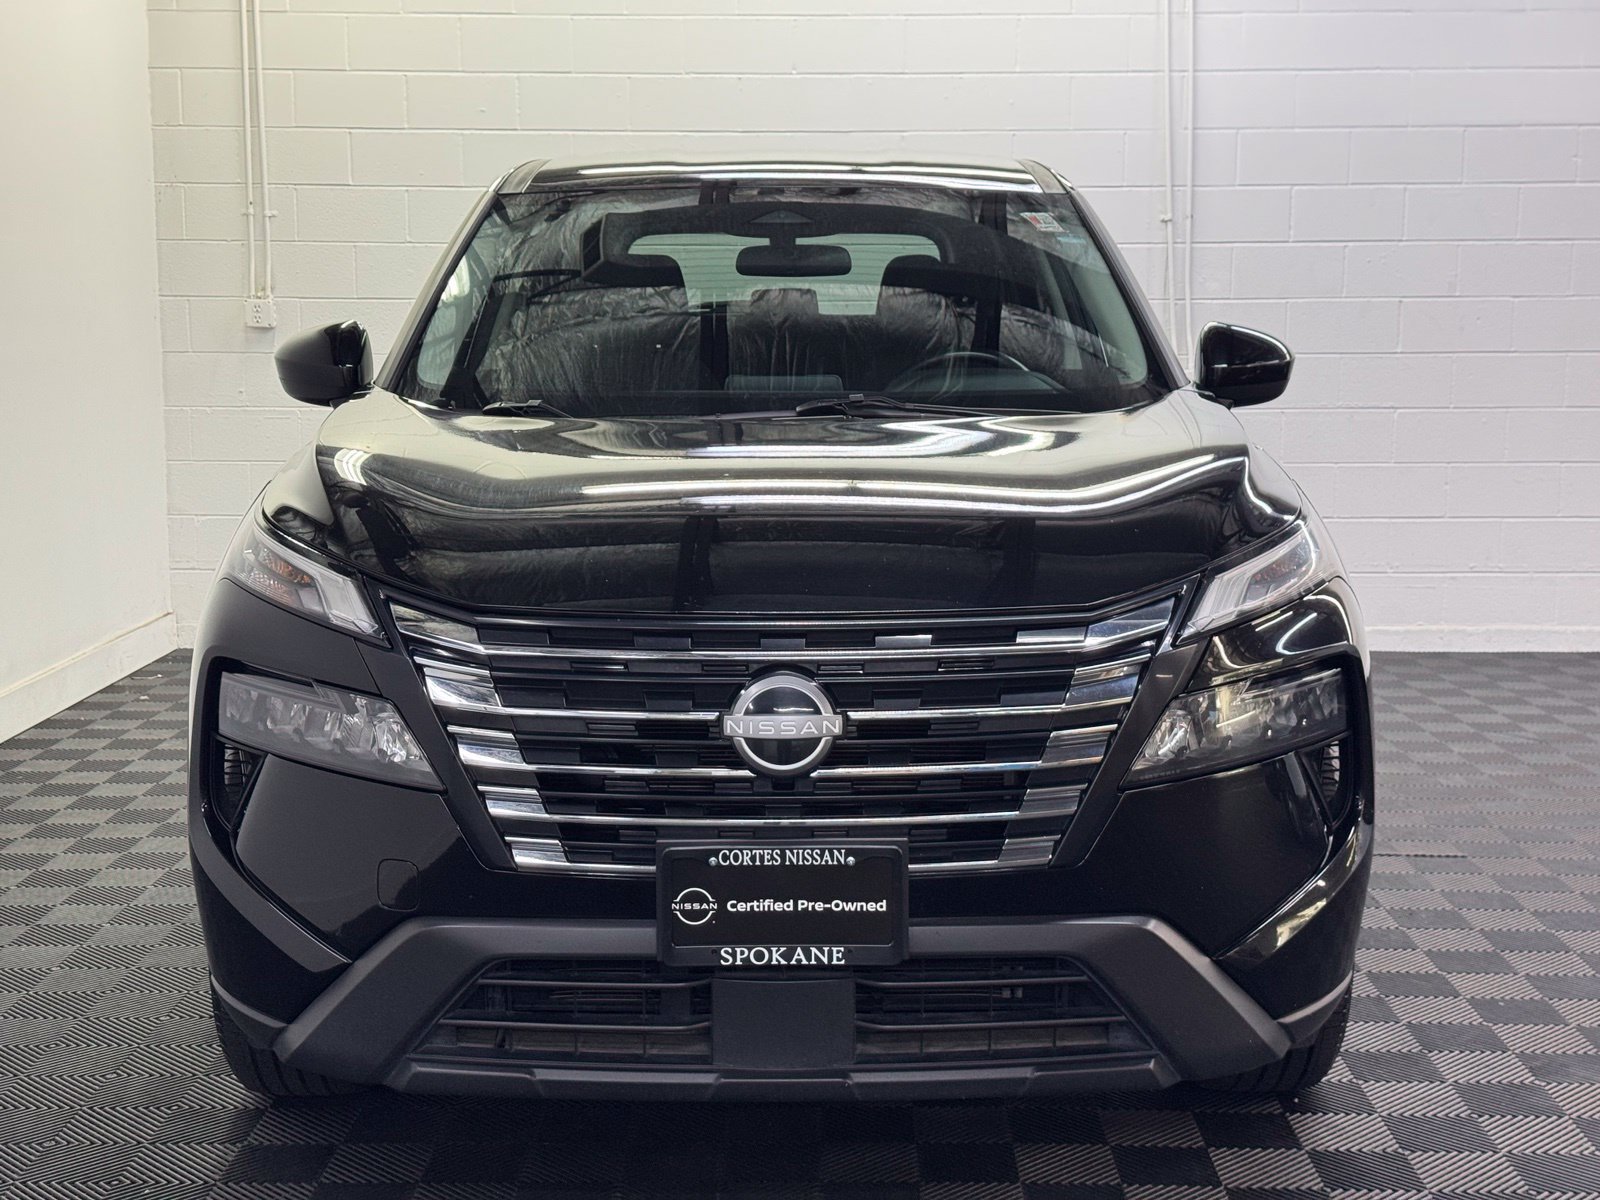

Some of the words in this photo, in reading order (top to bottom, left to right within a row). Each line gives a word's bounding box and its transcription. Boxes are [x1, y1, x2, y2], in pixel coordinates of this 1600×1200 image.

[726, 720, 840, 735] NISSAN
[718, 849, 781, 866] CORTES
[784, 849, 846, 866] NISSAN
[671, 902, 718, 910] NISSAN
[726, 899, 794, 912] Certified
[797, 899, 887, 912] Pre-Owned
[720, 946, 845, 966] SPOKANE
